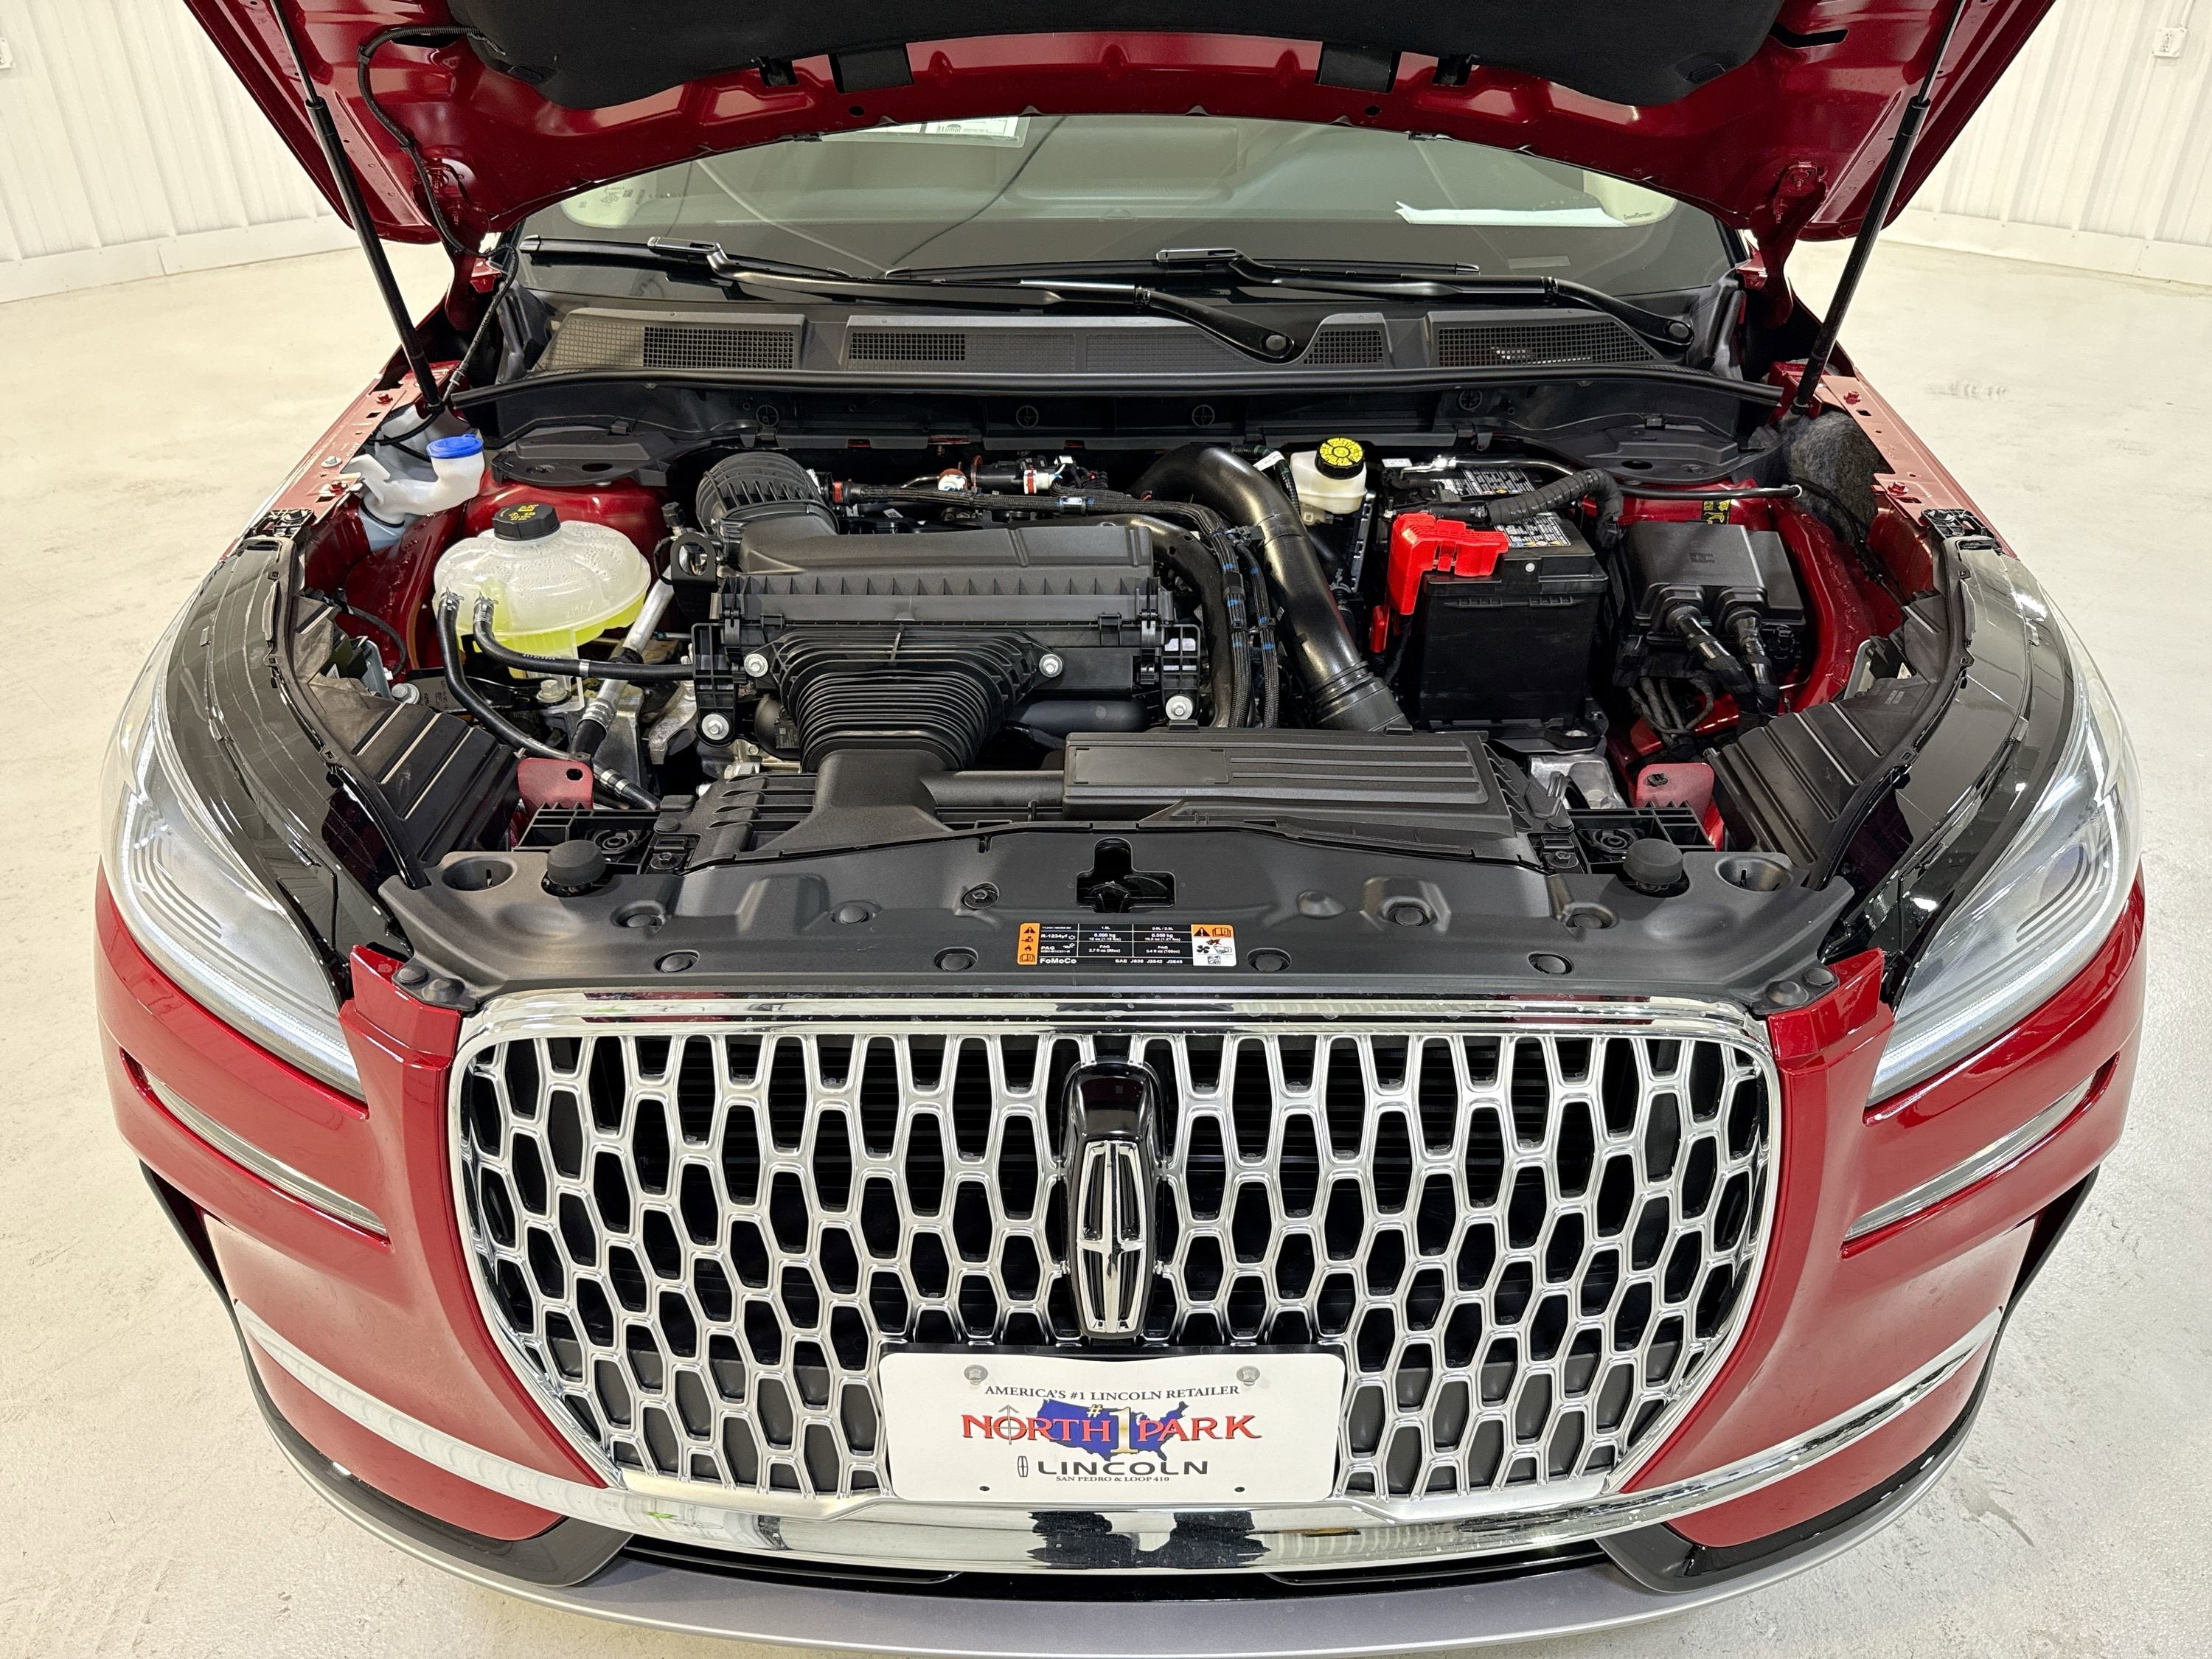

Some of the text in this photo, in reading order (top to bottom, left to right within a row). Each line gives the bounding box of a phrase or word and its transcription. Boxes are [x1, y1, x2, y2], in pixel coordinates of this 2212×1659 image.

[985, 1385, 1239, 1401] AMERICA'S #1 LINCOLN RETAILER
[961, 1413, 1112, 1443] NORTH
[1138, 1414, 1263, 1442] PARK
[1038, 1461, 1208, 1475] LINCOLN
